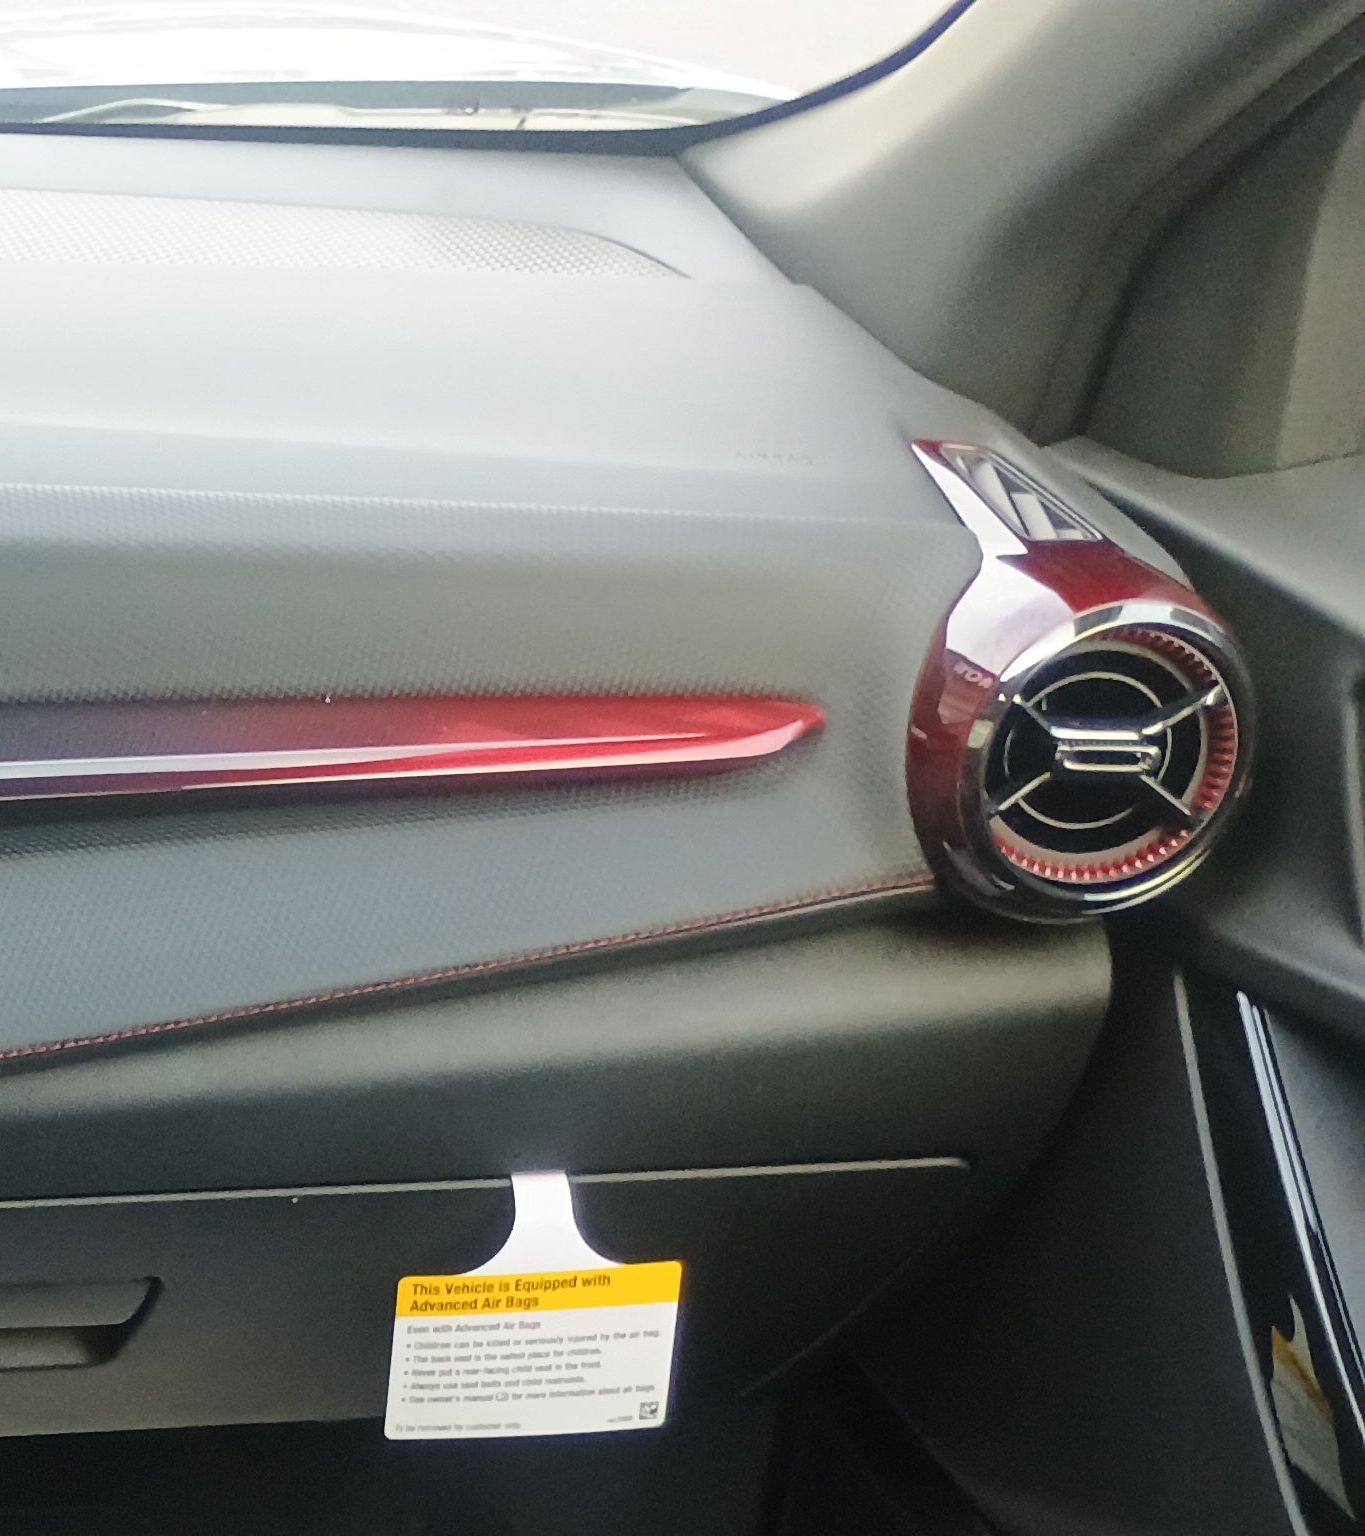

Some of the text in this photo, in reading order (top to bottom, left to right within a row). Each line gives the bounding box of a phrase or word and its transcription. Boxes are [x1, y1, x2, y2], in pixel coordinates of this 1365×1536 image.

[413, 1275, 610, 1295] This Vehicle is Equipped with
[410, 1296, 539, 1312] Advanced Air Bags
